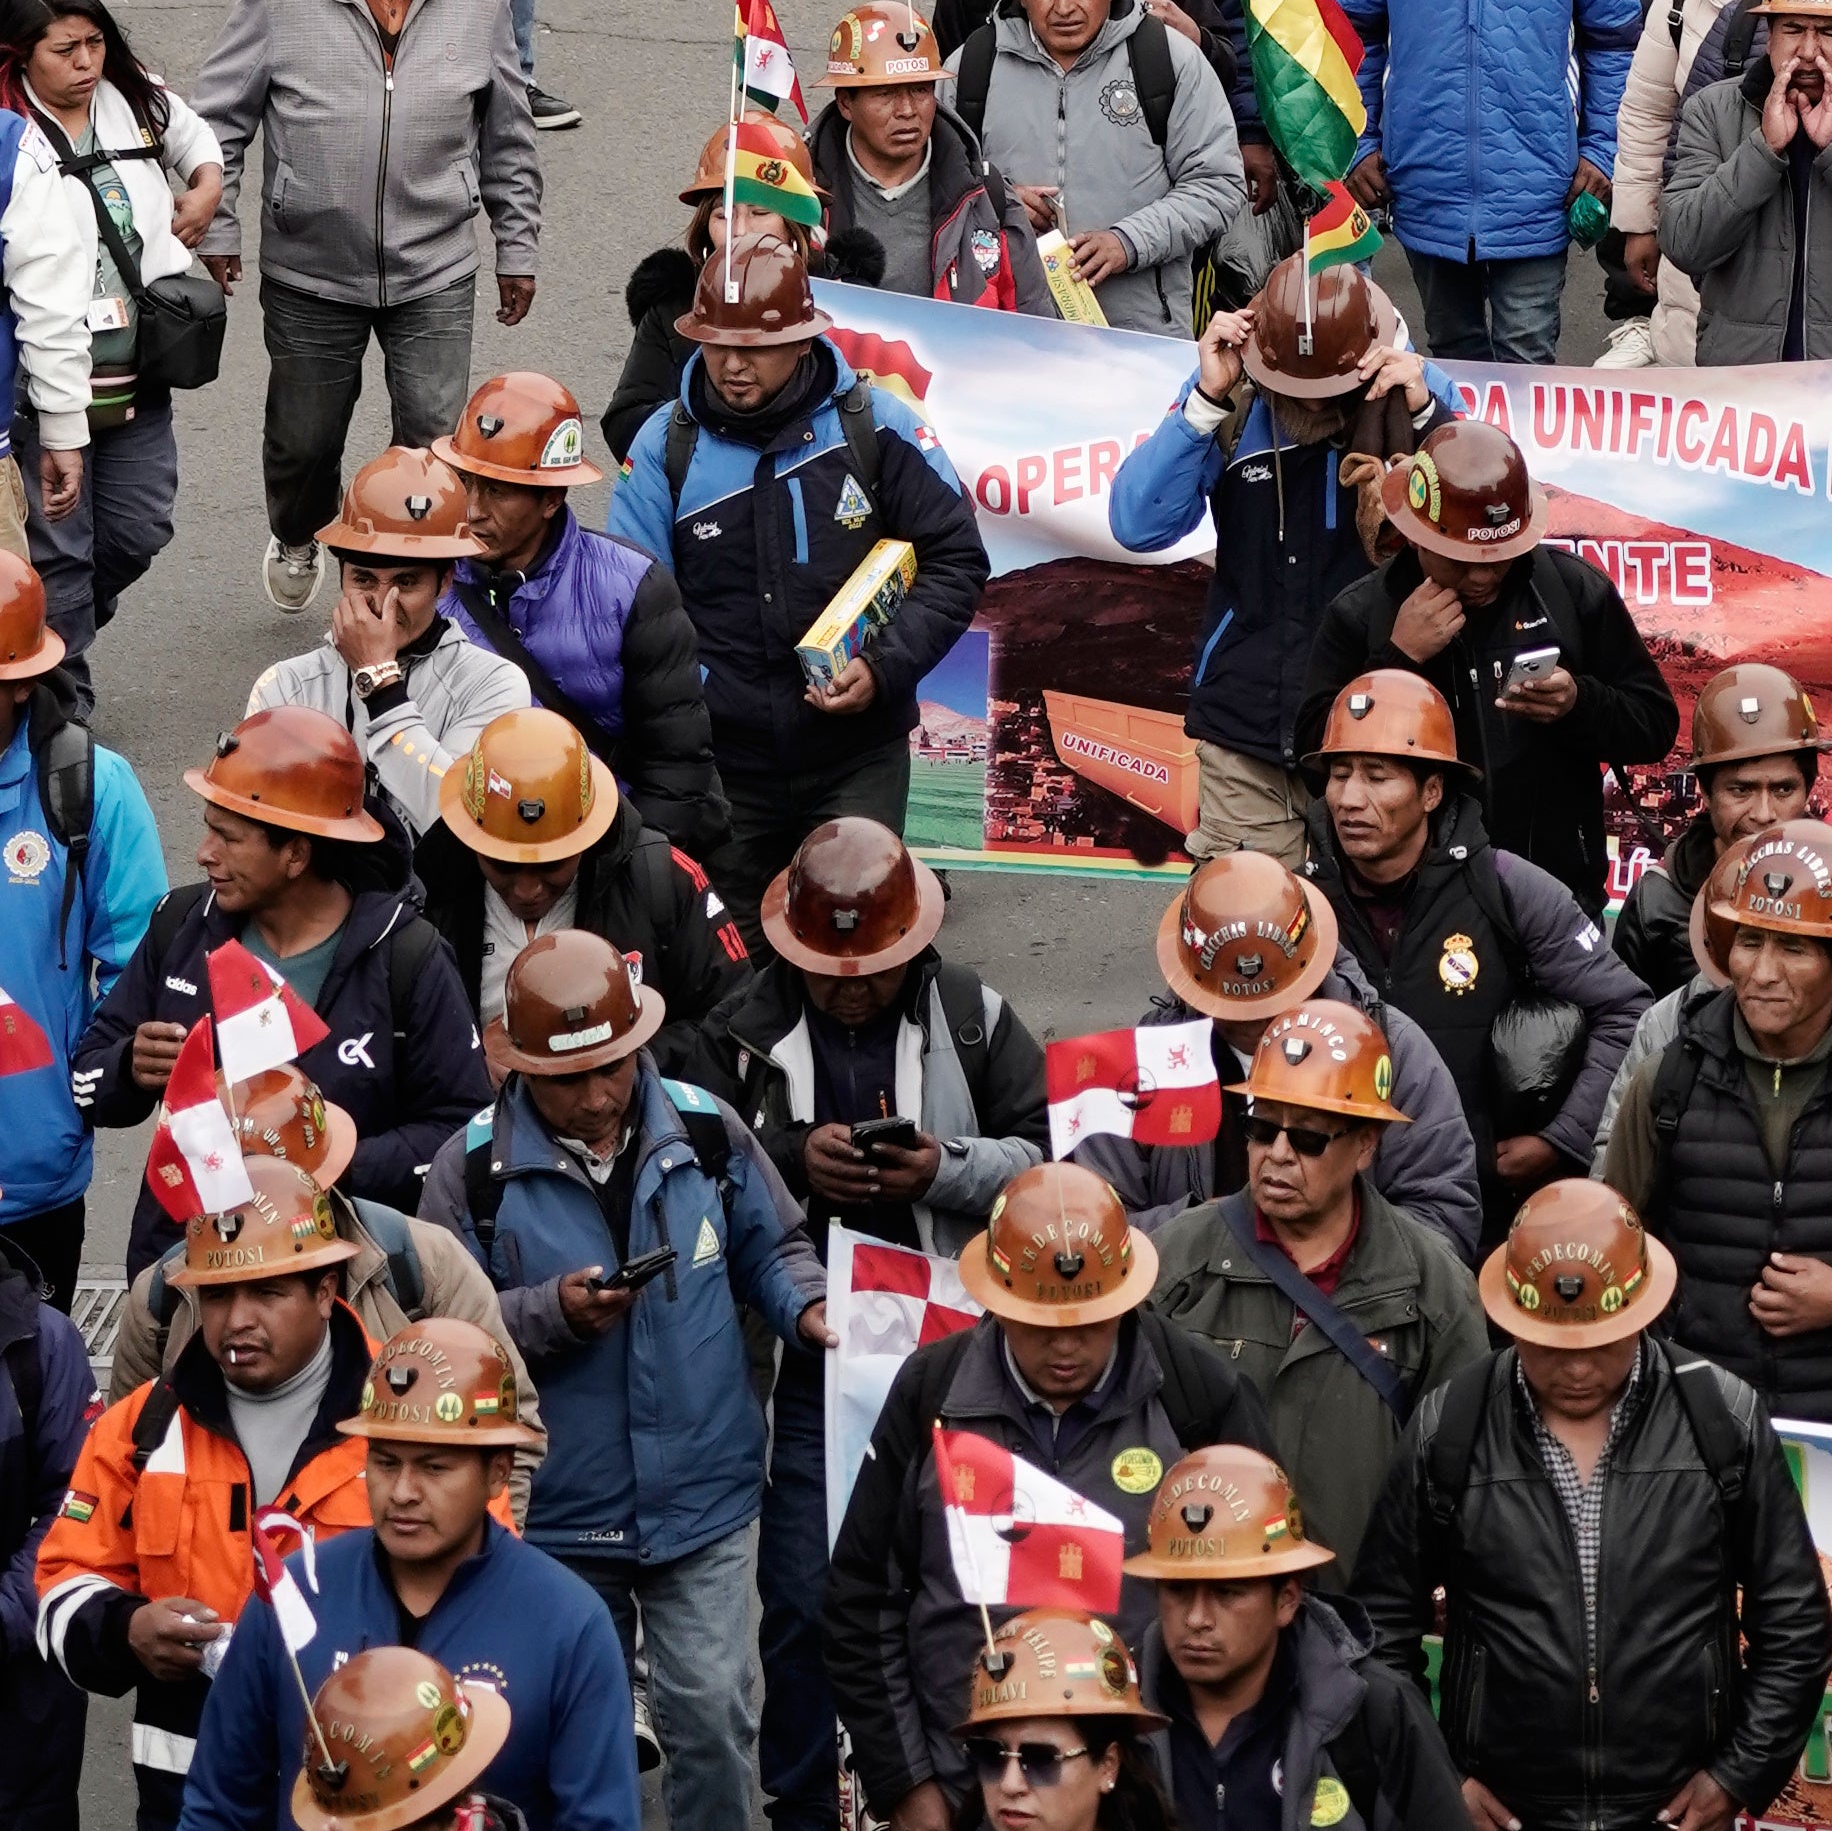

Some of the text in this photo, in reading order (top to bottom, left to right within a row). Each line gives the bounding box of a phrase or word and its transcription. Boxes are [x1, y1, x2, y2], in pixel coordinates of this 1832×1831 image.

[887, 58, 929, 75] POTOSI
[1533, 383, 1814, 494] UNIFICADA
[1466, 518, 1522, 542] POTOSI
[1062, 730, 1170, 785] UNIFICADA
[1748, 893, 1802, 921] POTOSI
[1222, 977, 1275, 998] POTOSI
[1262, 1013, 1348, 1062] SERMINCO
[207, 1247, 265, 1269] POTOSI
[1525, 1241, 1618, 1287] FEDECOMIN
[372, 1399, 432, 1425] POTOSI
[1168, 1537, 1226, 1558] POTOSI
